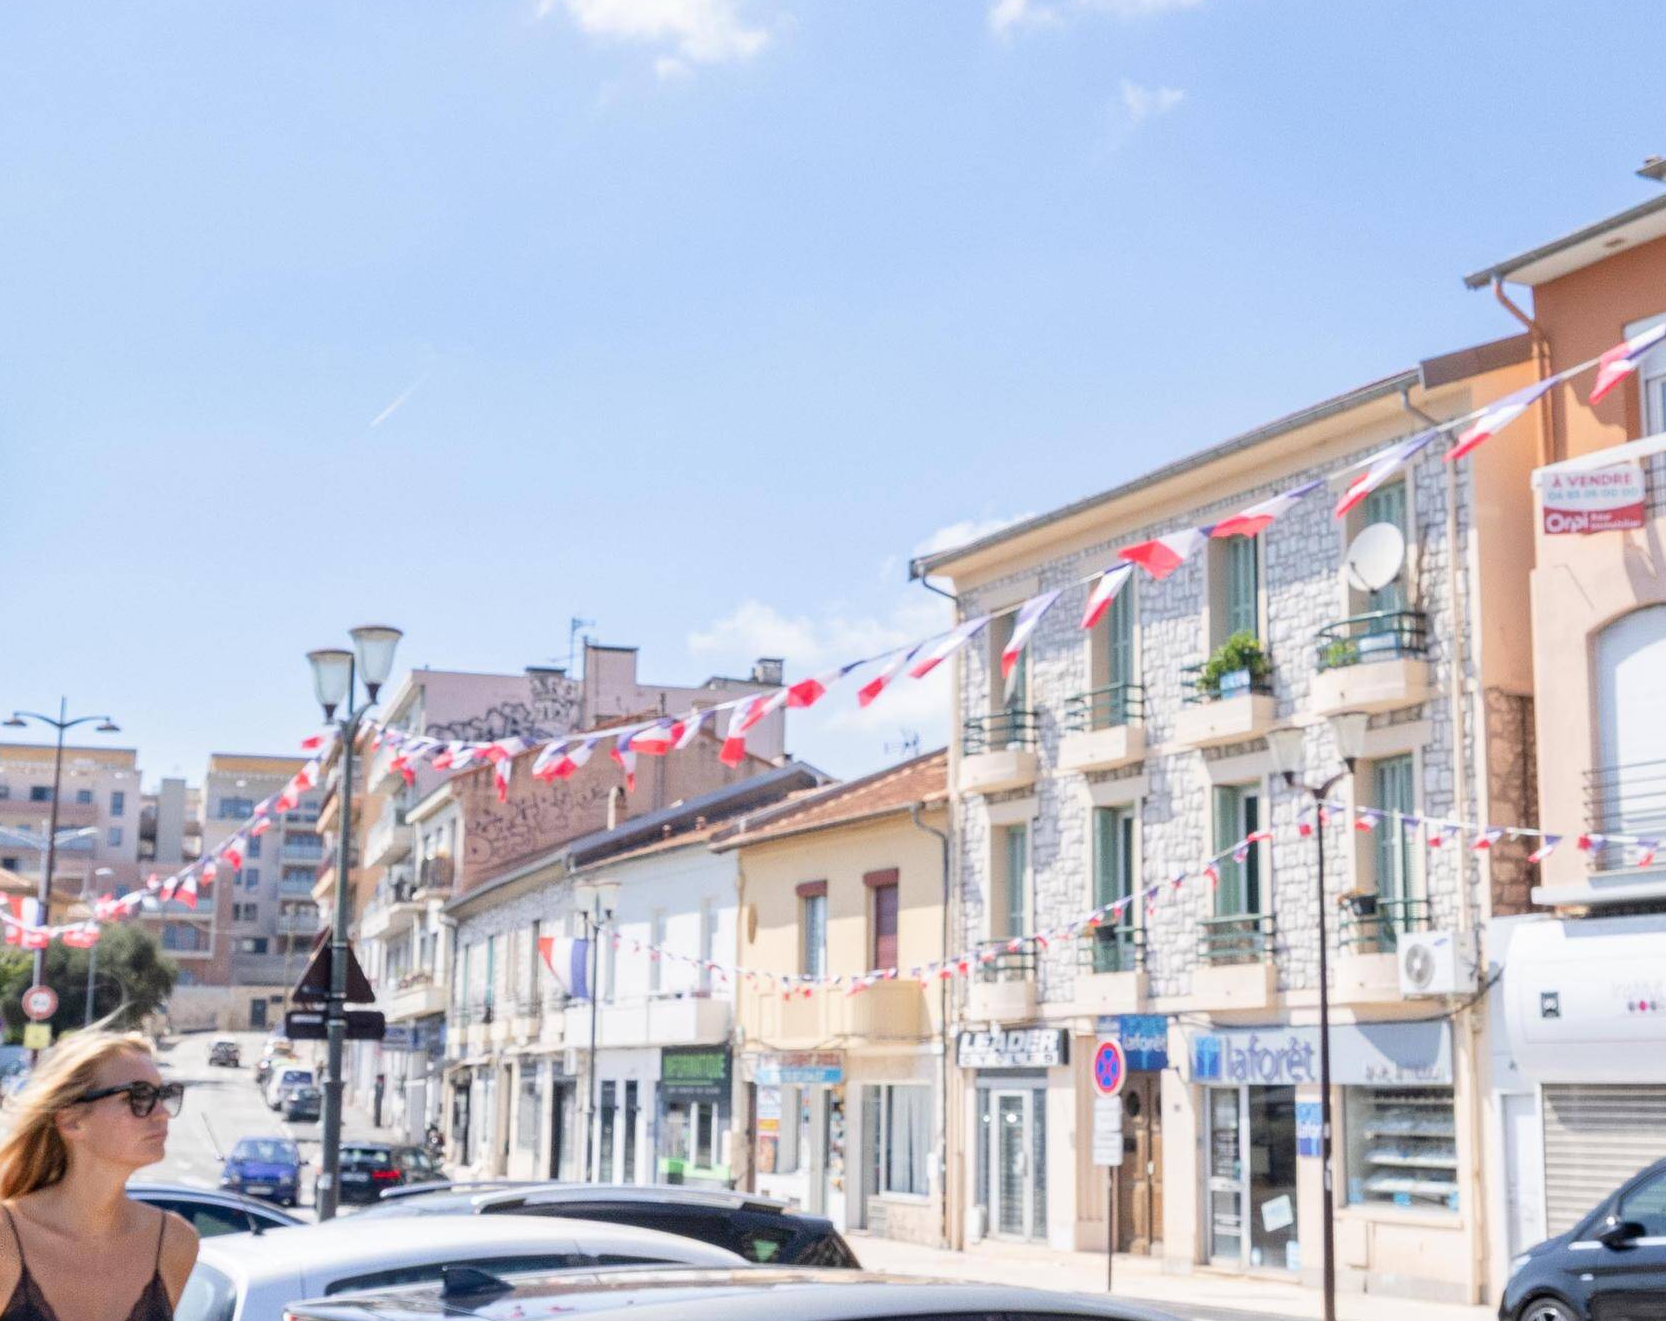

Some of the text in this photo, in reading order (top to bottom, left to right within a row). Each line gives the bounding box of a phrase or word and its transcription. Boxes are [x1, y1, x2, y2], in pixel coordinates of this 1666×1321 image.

[1567, 473, 1632, 488] VENDRE
[1546, 510, 1590, 534] Orpi
[958, 1028, 1061, 1055] LEADER
[1225, 1033, 1316, 1082] laforêt
